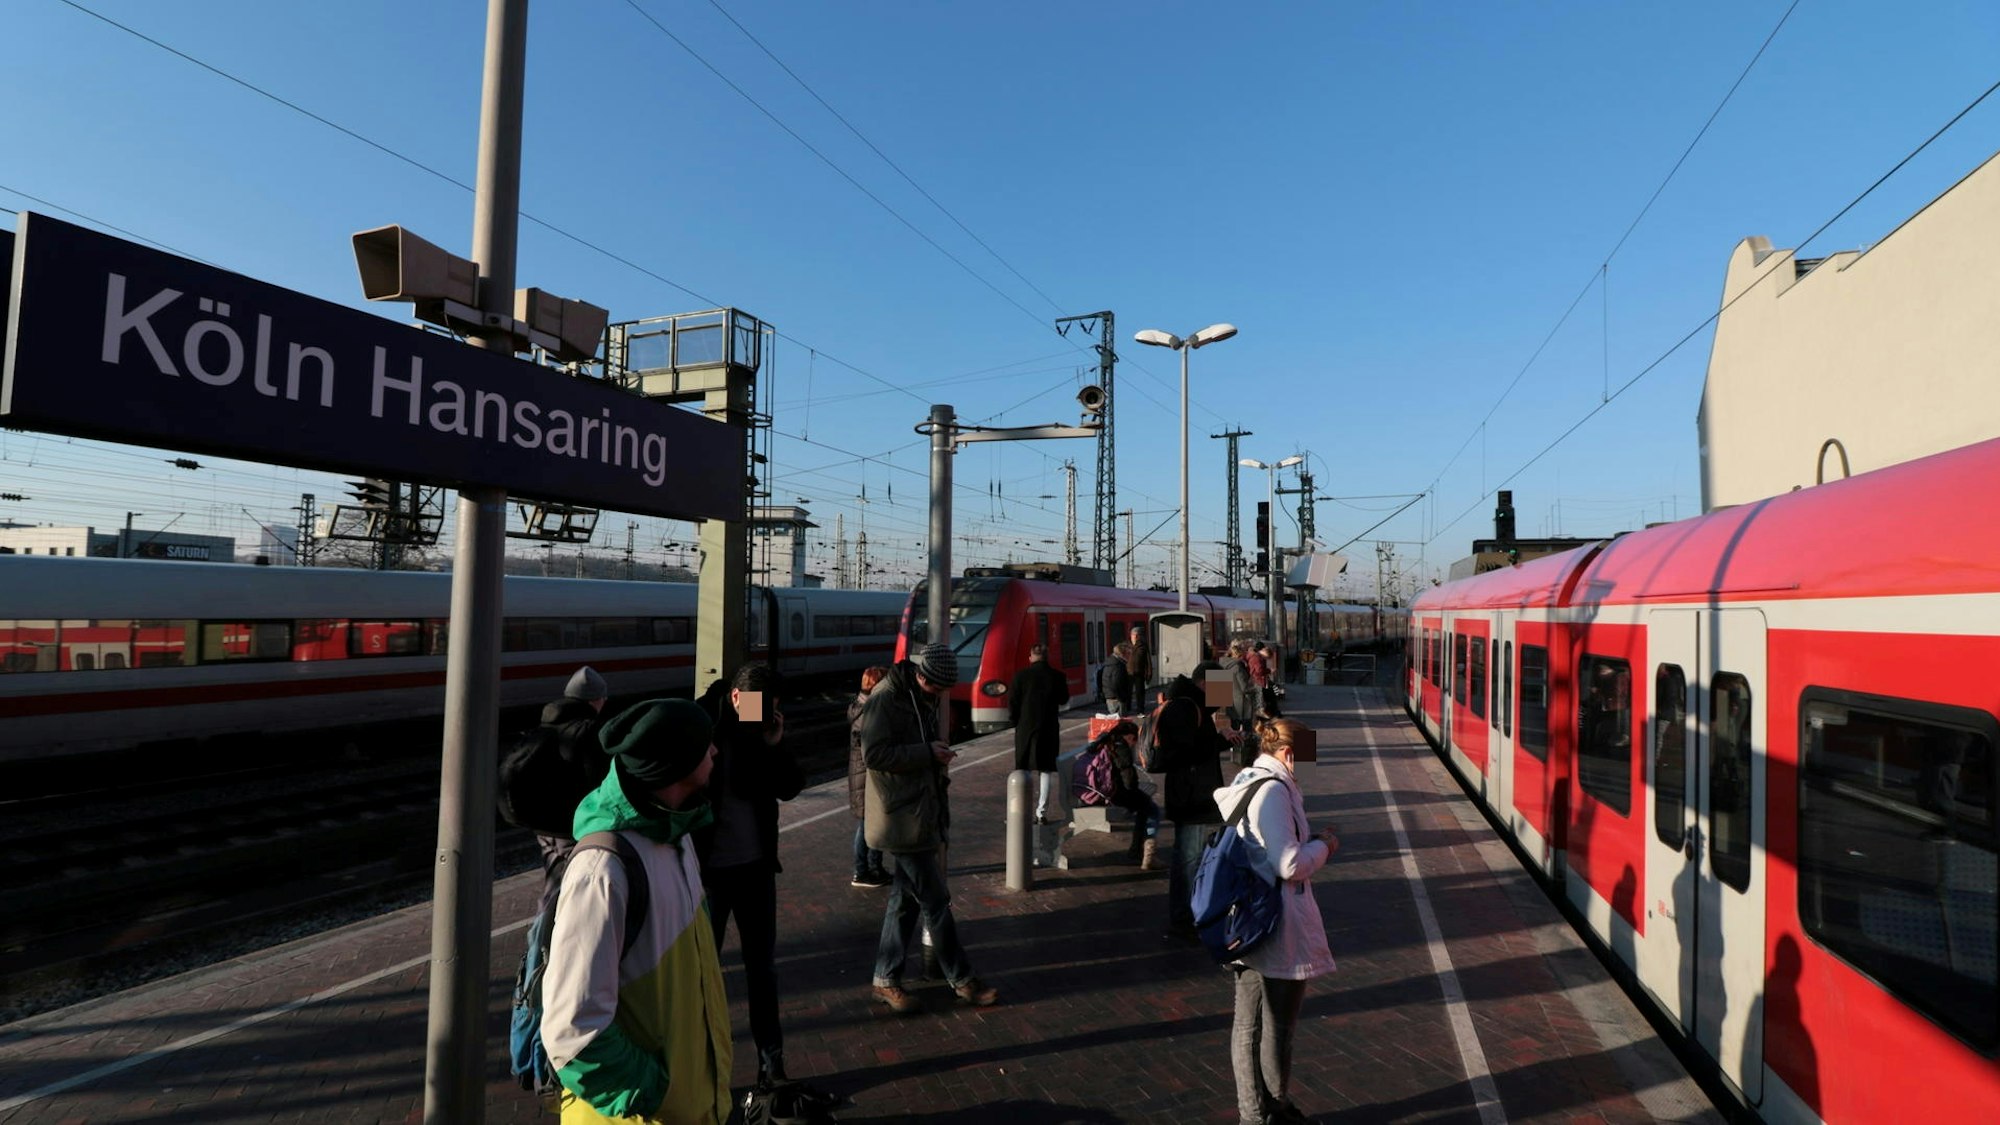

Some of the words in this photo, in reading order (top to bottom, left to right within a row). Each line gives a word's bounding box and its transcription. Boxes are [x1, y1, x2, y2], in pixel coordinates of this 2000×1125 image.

[102, 272, 335, 408] Köln
[371, 345, 667, 487] Hansaring
[166, 544, 209, 559] SATURN
